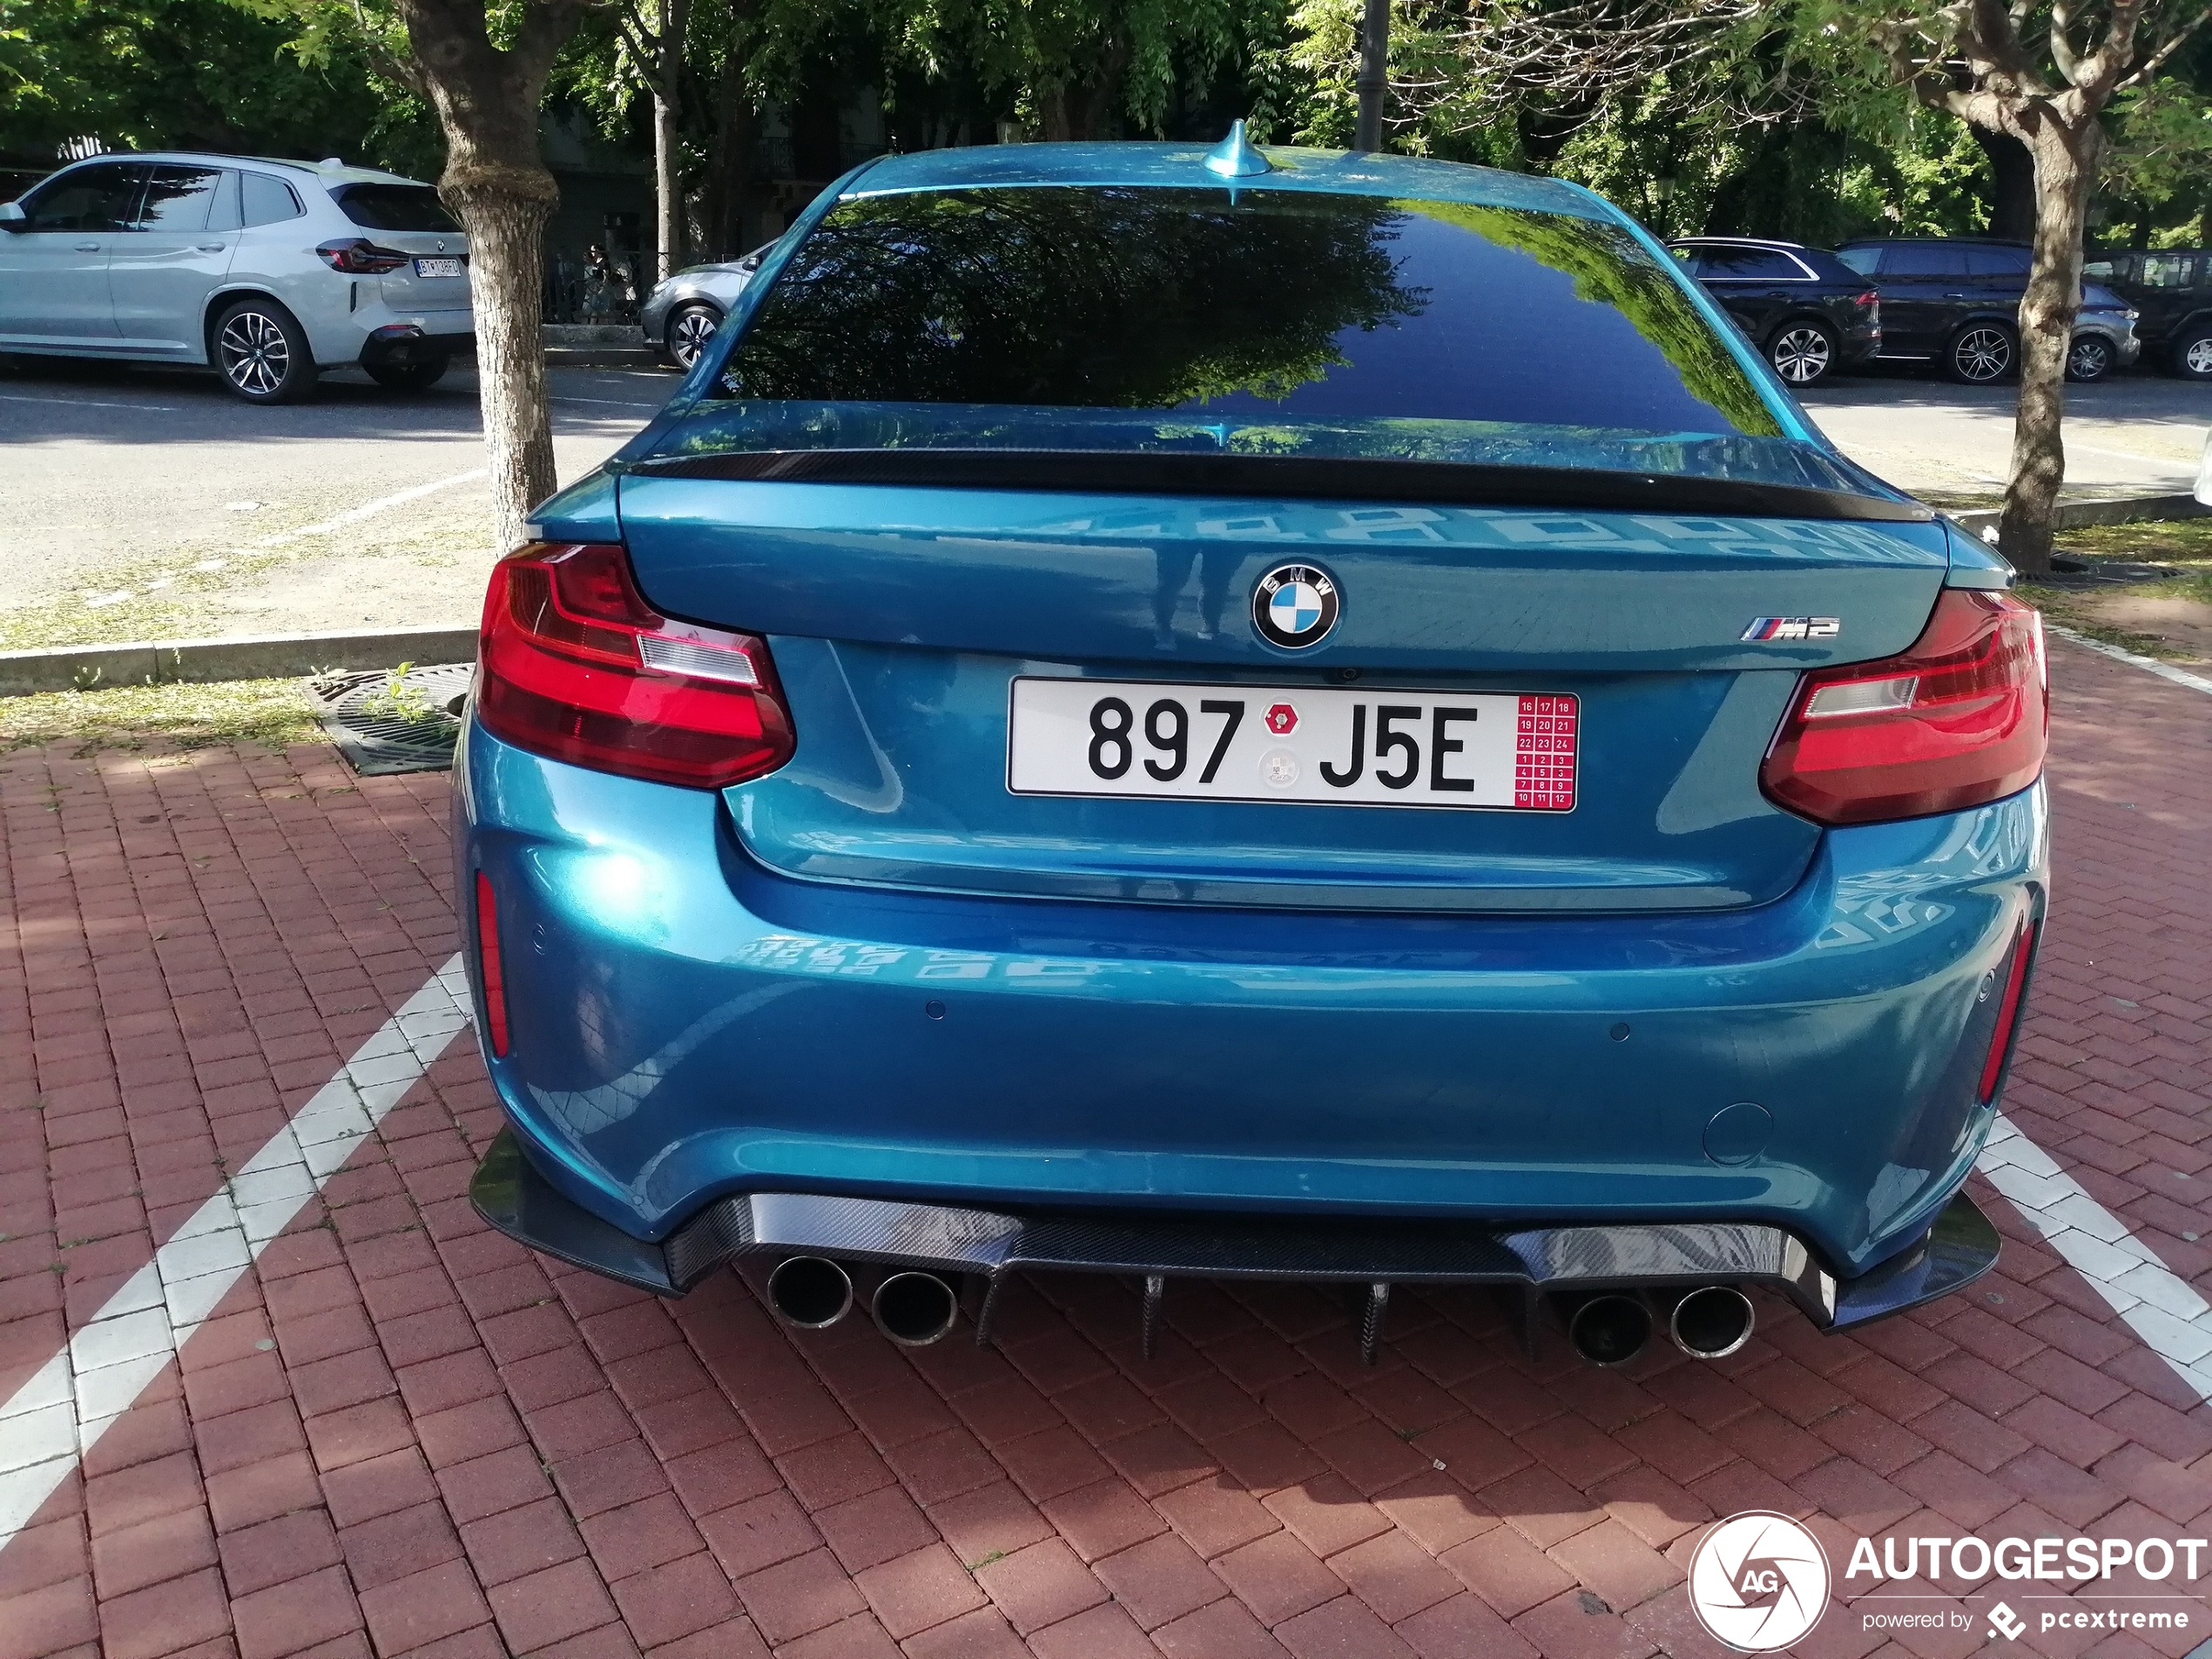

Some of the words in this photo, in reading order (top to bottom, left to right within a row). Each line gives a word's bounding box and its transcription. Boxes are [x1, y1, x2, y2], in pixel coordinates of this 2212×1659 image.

[1263, 567, 1332, 597] BMW
[1766, 617, 1840, 641] M2
[1521, 702, 1532, 711] 16
[1540, 702, 1550, 712] 17
[1558, 703, 1569, 713] 18
[1521, 720, 1532, 730] 19
[1539, 721, 1550, 730] 20
[1557, 721, 1568, 731] 21
[1089, 697, 1245, 784] 897
[1319, 704, 1478, 792] J5E
[1520, 738, 1531, 748] 22
[1538, 738, 1549, 748] 23
[1556, 739, 1568, 749] 24
[1537, 793, 1546, 802] 11
[1555, 794, 1565, 803] 12
